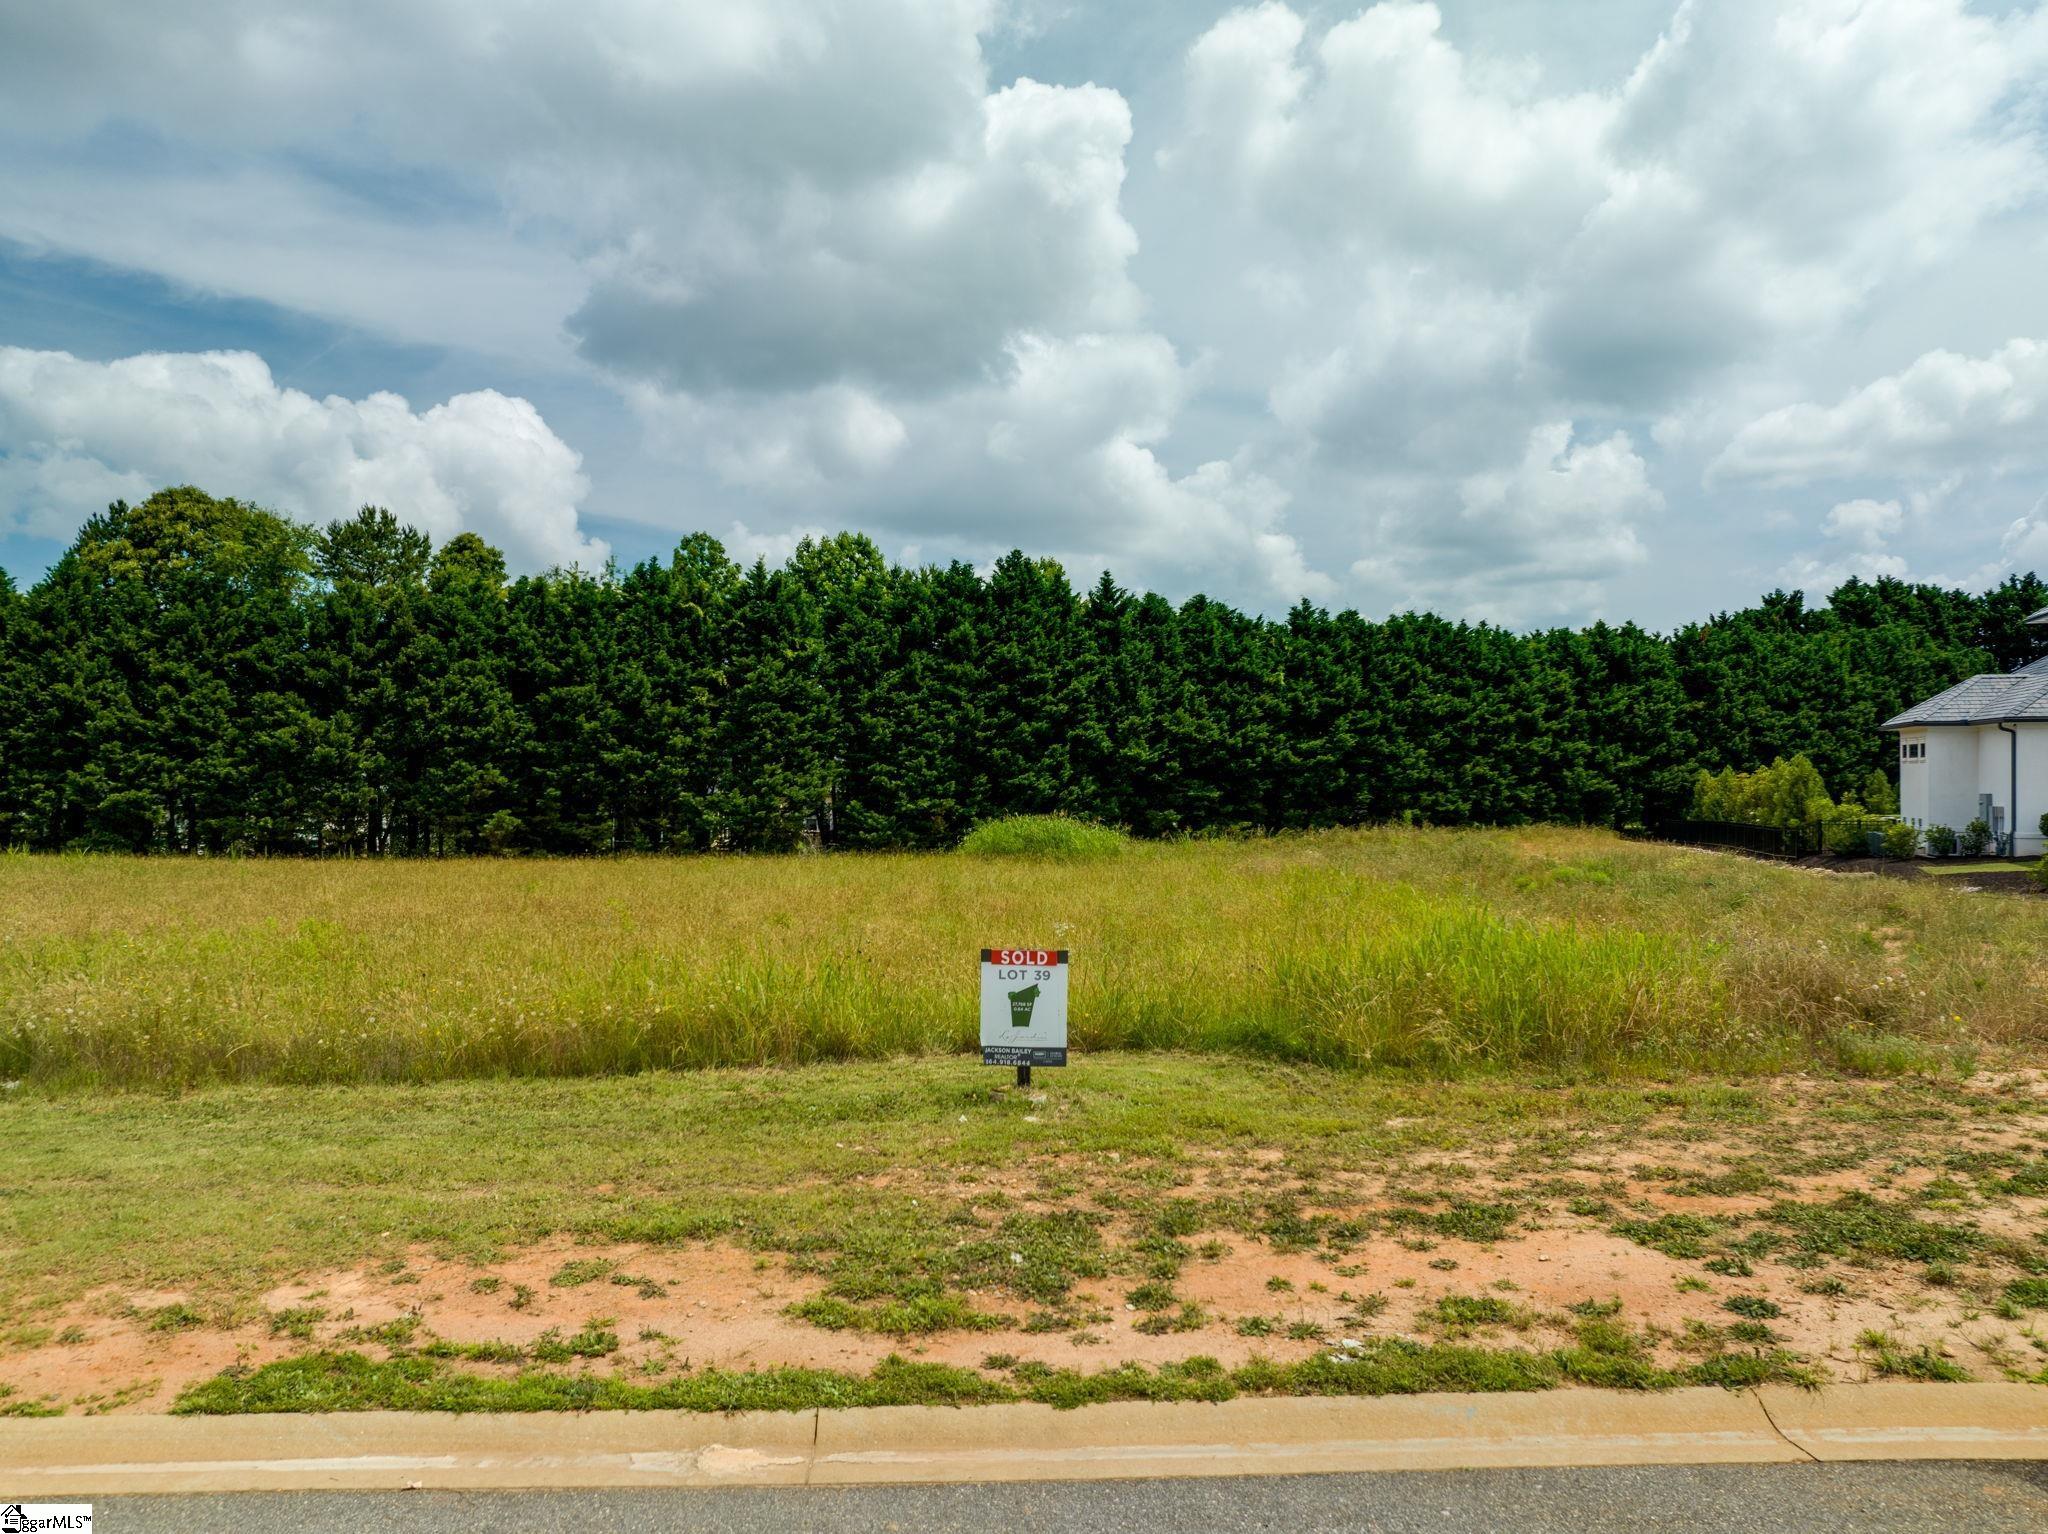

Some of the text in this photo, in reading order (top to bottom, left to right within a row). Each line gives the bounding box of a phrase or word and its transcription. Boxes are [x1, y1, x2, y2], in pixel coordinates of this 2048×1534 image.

[1000, 950, 1048, 965] SOLD
[998, 969, 1051, 981] LOT 39
